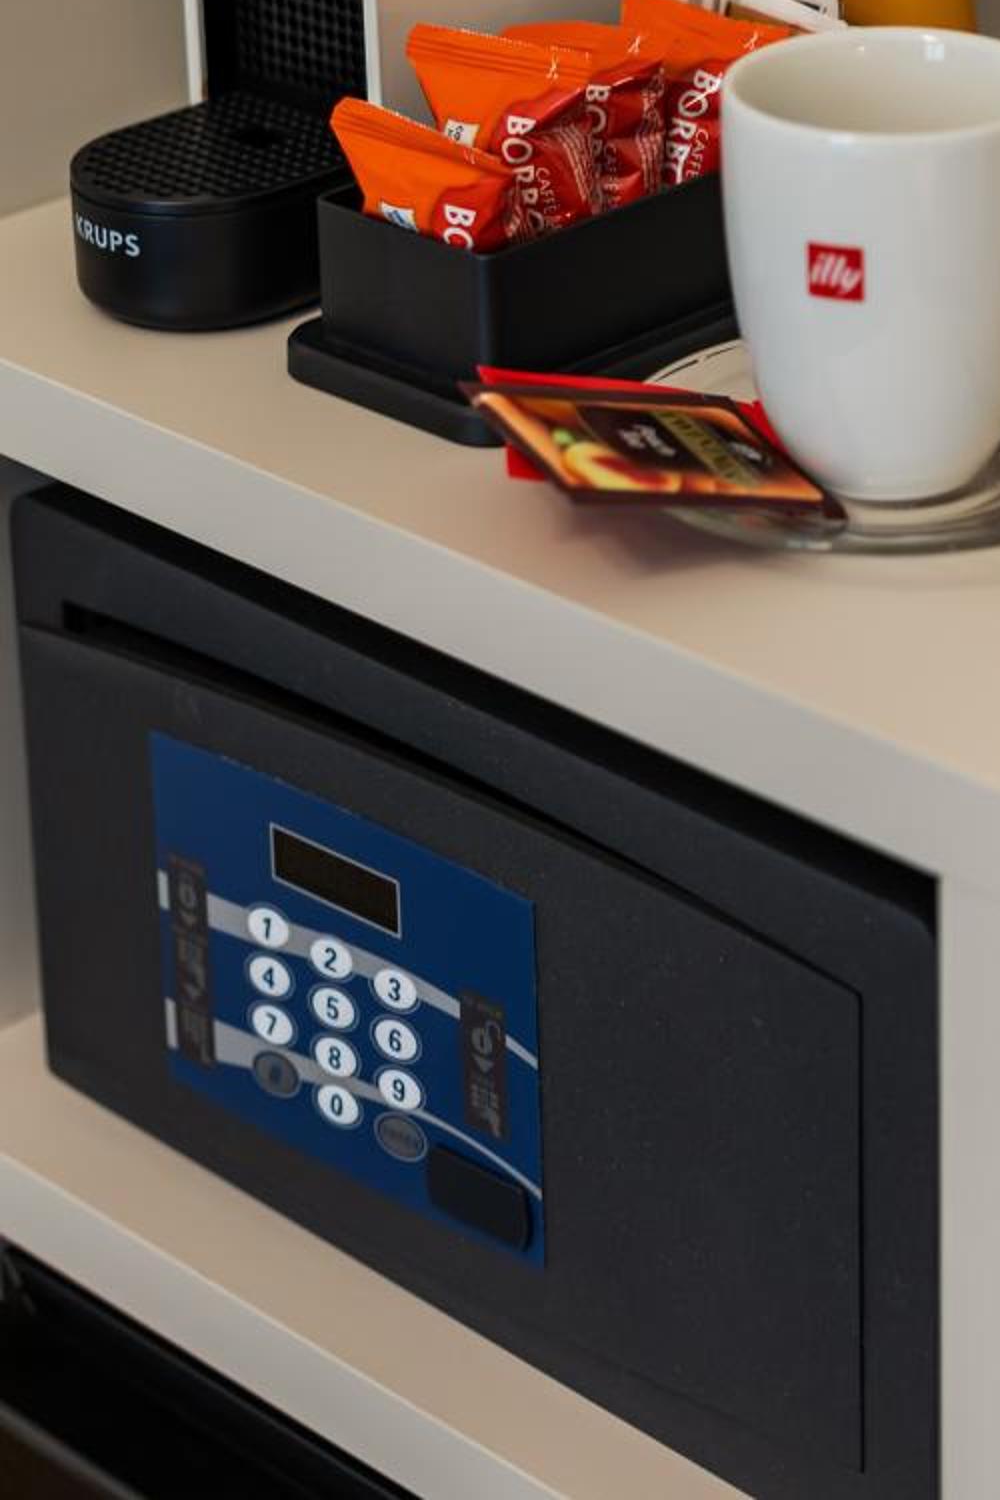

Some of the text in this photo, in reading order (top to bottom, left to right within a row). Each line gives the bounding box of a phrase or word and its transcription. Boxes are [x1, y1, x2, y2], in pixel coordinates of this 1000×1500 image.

[76, 212, 140, 257] KRUPS
[811, 252, 861, 297] illy
[262, 917, 401, 1001] 1 2 3
[262, 966, 402, 1053] 4 5 6
[265, 1012, 405, 1103] 7 8 9
[329, 1093, 343, 1117] 0
